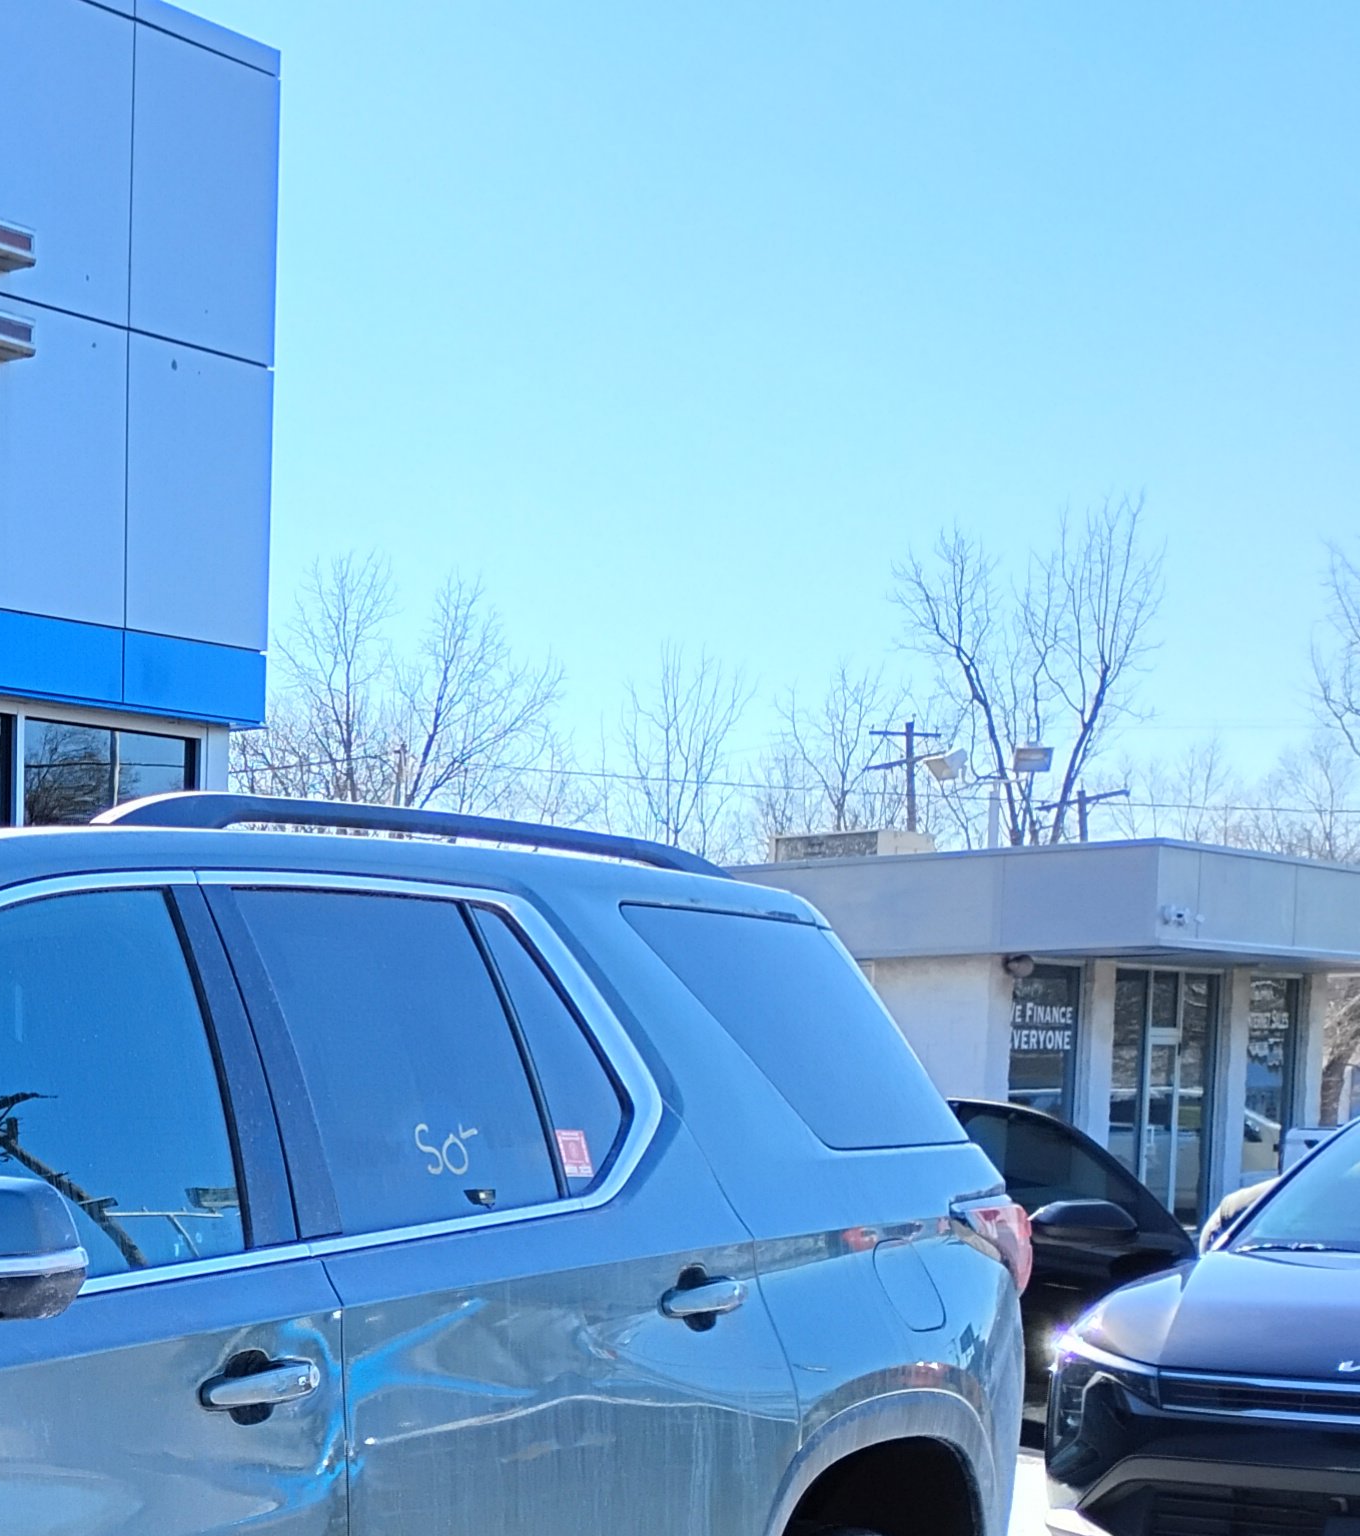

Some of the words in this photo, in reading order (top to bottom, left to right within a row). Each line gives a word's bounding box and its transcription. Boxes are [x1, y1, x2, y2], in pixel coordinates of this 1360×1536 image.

[1011, 1002, 1022, 1023] E
[1025, 1002, 1073, 1024] FINANCE
[1011, 1029, 1072, 1050] VERYONE
